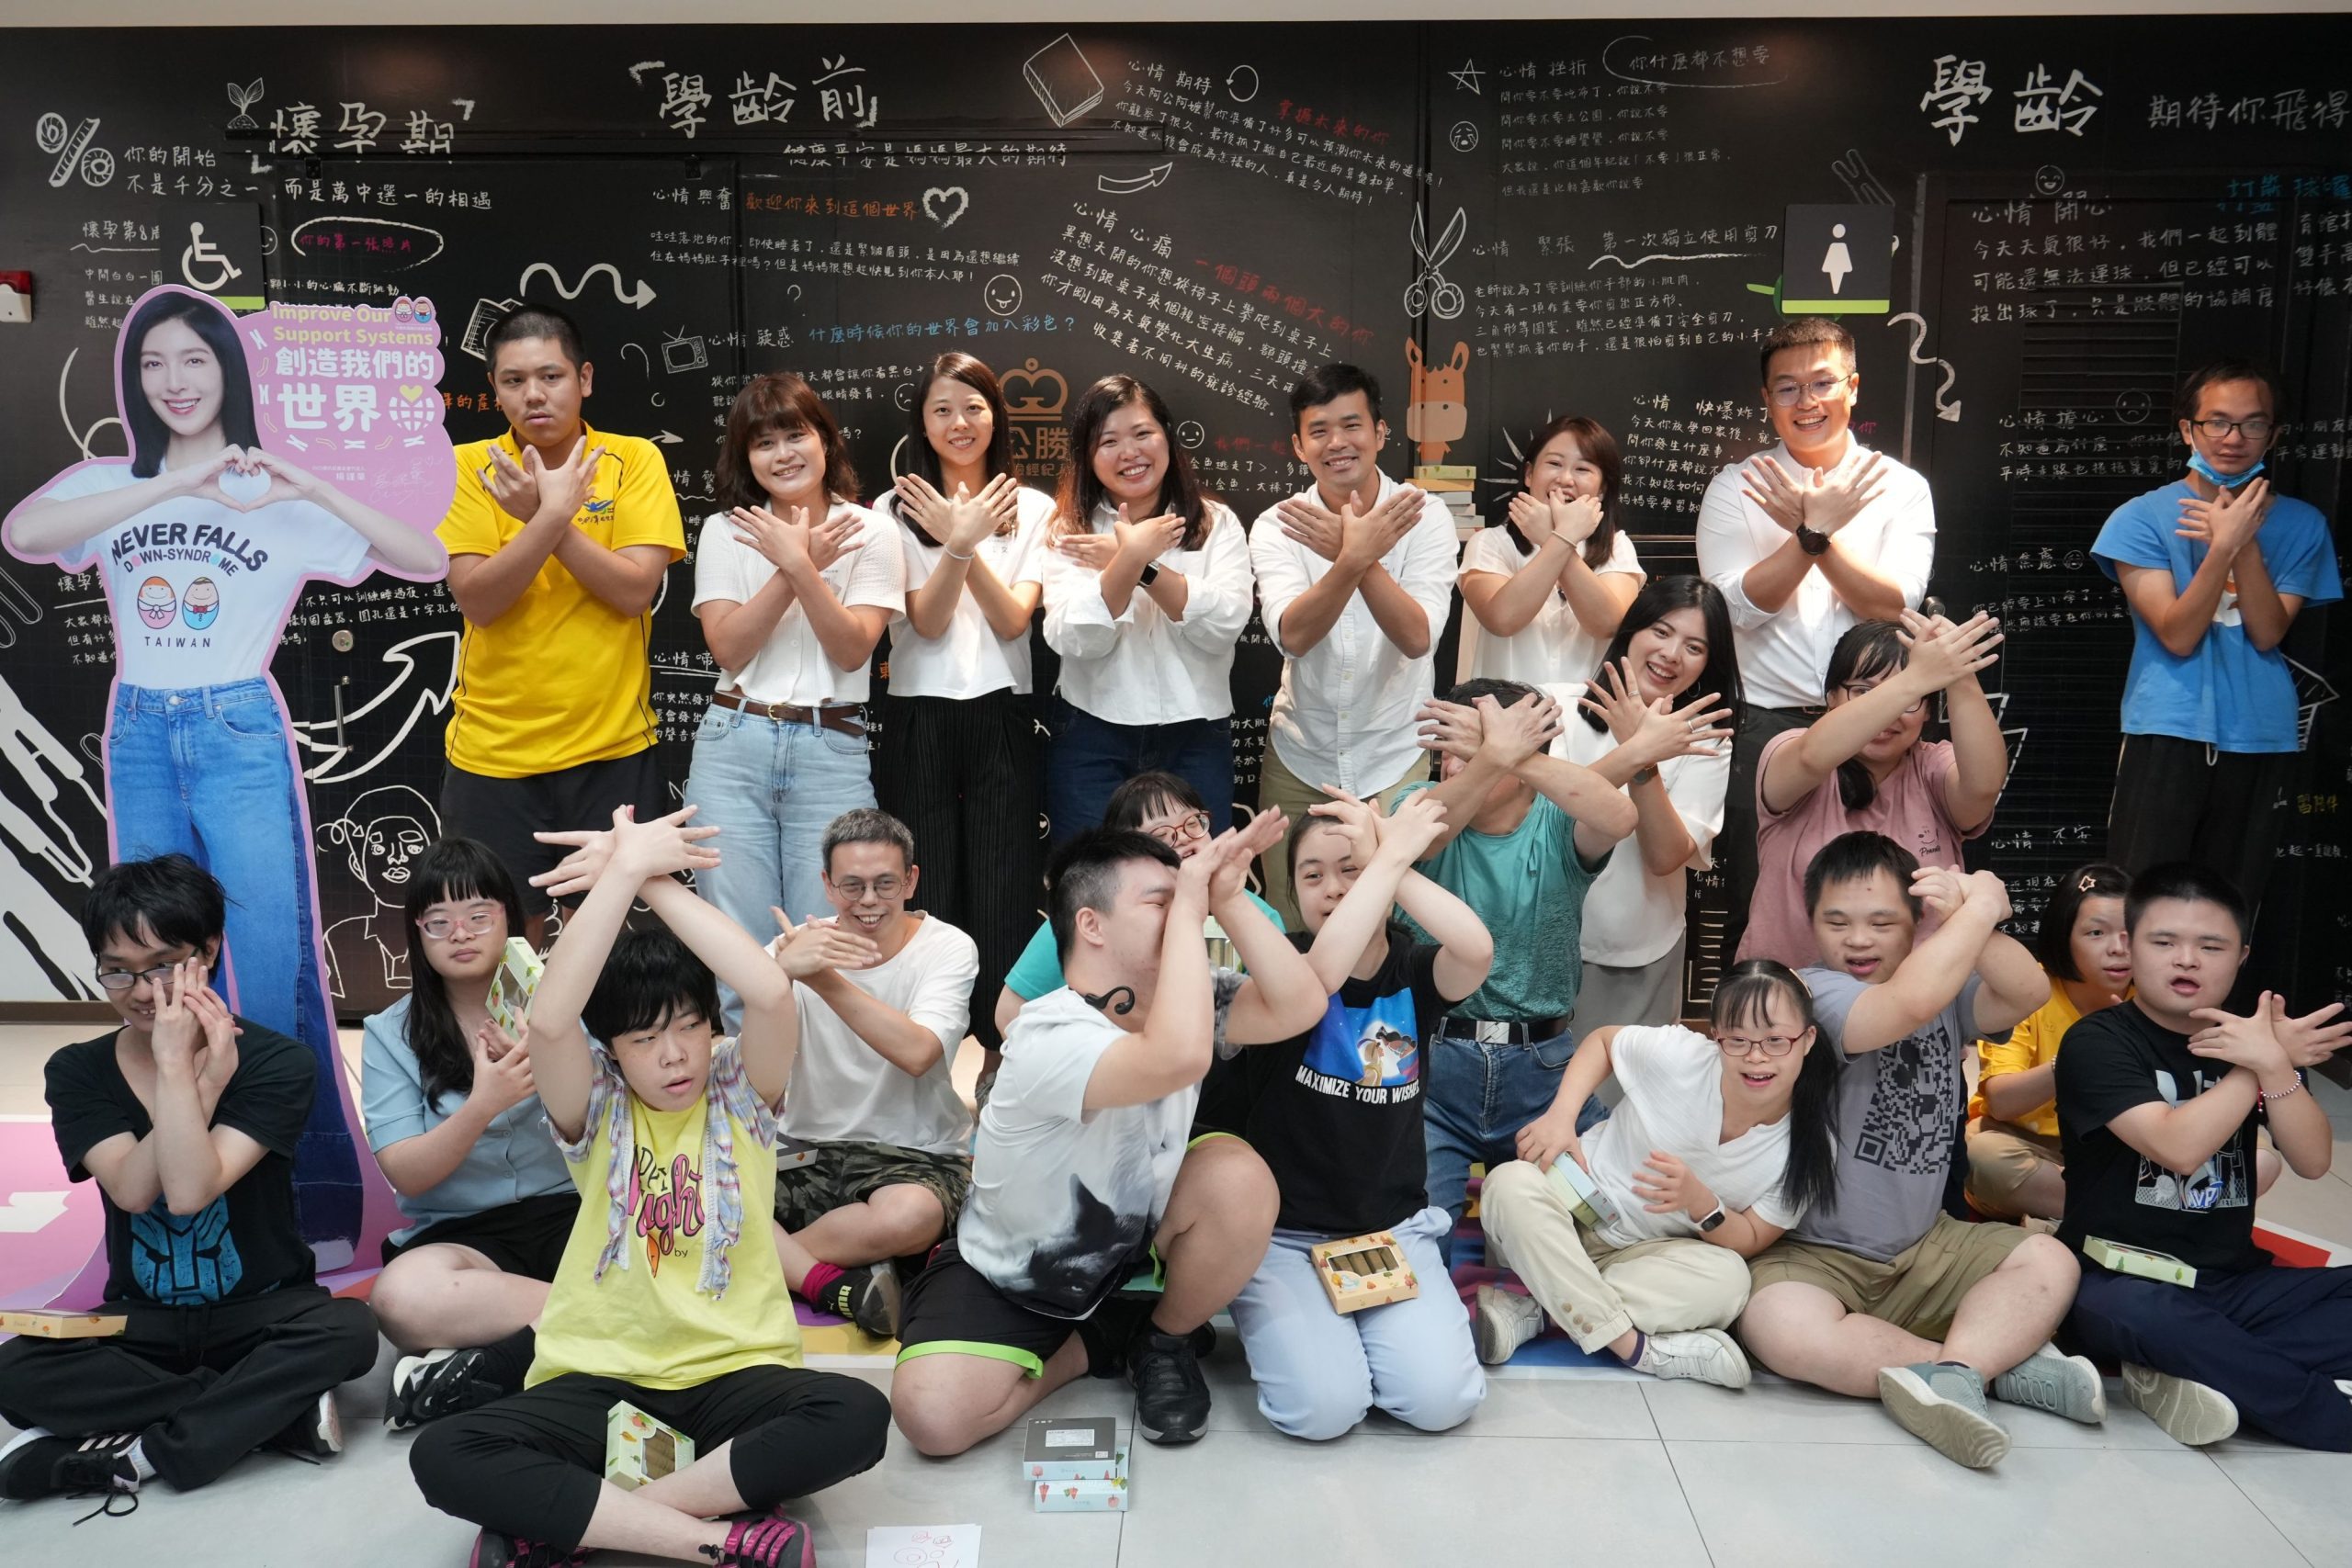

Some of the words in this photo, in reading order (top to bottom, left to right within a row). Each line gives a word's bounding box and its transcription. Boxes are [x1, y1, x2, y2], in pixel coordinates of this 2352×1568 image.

[1499, 62, 1537, 80] 心情
[1629, 45, 1770, 73] 你什麼都不想要
[1128, 60, 1166, 83] 心情
[1176, 71, 1213, 96] 期待
[1919, 53, 2103, 146] 學齡
[124, 145, 218, 167] 你的開始
[652, 186, 689, 206] 心情
[697, 186, 733, 211] 興奮
[745, 191, 917, 218] 歡迎你來到這個世界
[1973, 194, 2035, 226] 心情
[2054, 190, 2113, 225] 開心
[1073, 201, 1119, 233] 心情
[1130, 226, 1173, 259] 心痛
[1602, 224, 1779, 254] 第一次獨立使用剪刀
[299, 232, 413, 254] 你的第一張照片
[1472, 241, 1510, 258] 心情
[1538, 235, 1576, 255] 緊張
[1193, 257, 1374, 345] 一個頭兩個大的你
[272, 307, 353, 322] Improve
[356, 307, 391, 322] Our
[274, 326, 352, 344] Support
[356, 328, 434, 347] Systems
[708, 331, 746, 348] 心情
[757, 326, 795, 348] 疑惑
[275, 347, 435, 379] 創造我們的
[277, 382, 381, 433] 世界
[1634, 394, 1671, 412] 心情
[1695, 399, 1770, 423] 快爆炸了
[1999, 411, 2047, 431] 心情
[670, 469, 691, 488] 情
[111, 522, 187, 566] NEVER
[193, 525, 268, 571] FALLS
[1970, 553, 2009, 573] 心情
[144, 636, 211, 649] TAIWAN
[654, 650, 690, 668] 心情
[1991, 830, 2033, 851] 心情
[1295, 1065, 1351, 1099] MAXIMIZE
[1355, 1085, 1388, 1105] YOUR
[674, 1247, 689, 1258] by
